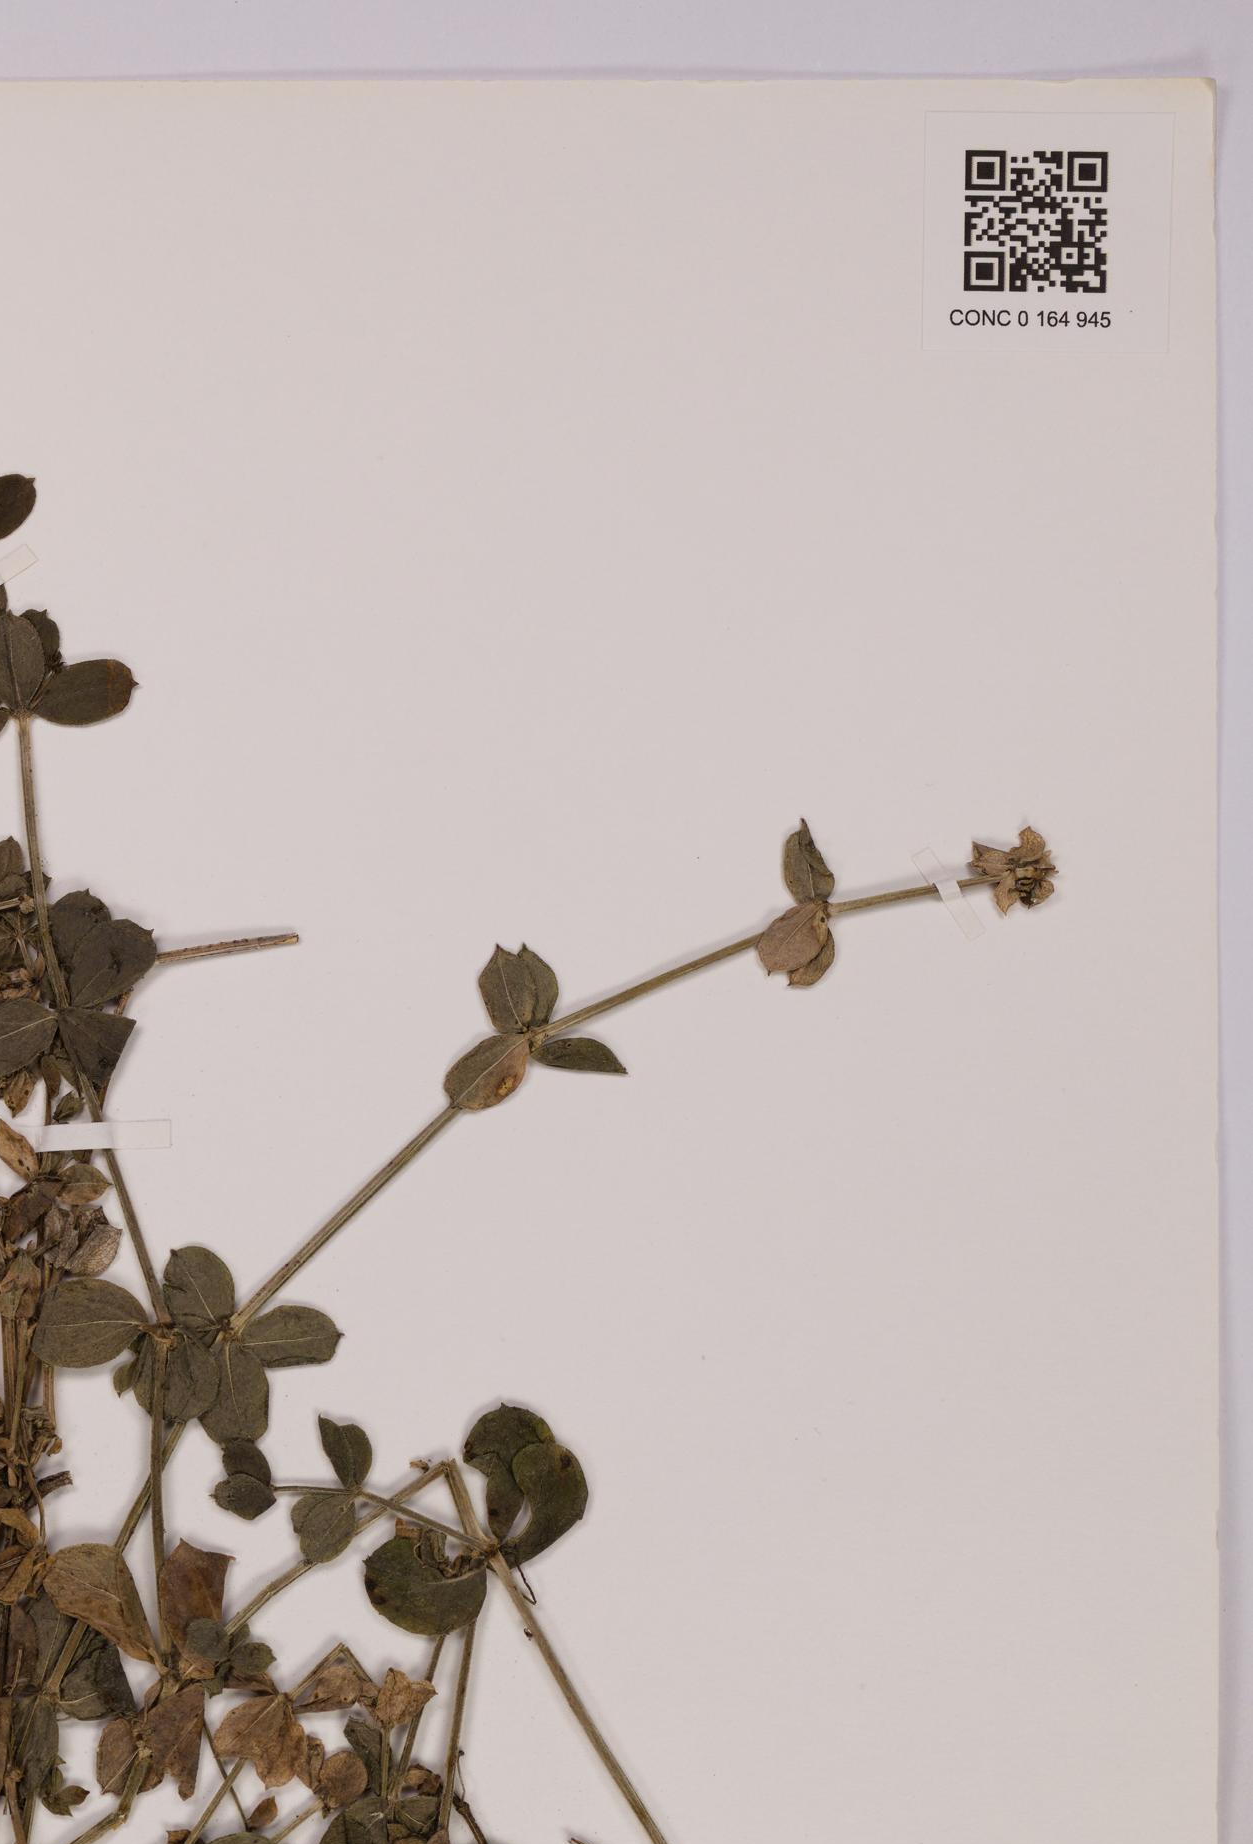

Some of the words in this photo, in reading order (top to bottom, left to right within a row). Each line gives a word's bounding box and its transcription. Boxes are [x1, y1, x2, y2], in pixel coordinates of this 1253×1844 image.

[949, 308, 1012, 327] CONC
[1017, 310, 1029, 327] 0
[1036, 310, 1071, 328] 164
[1076, 311, 1112, 329] 945
